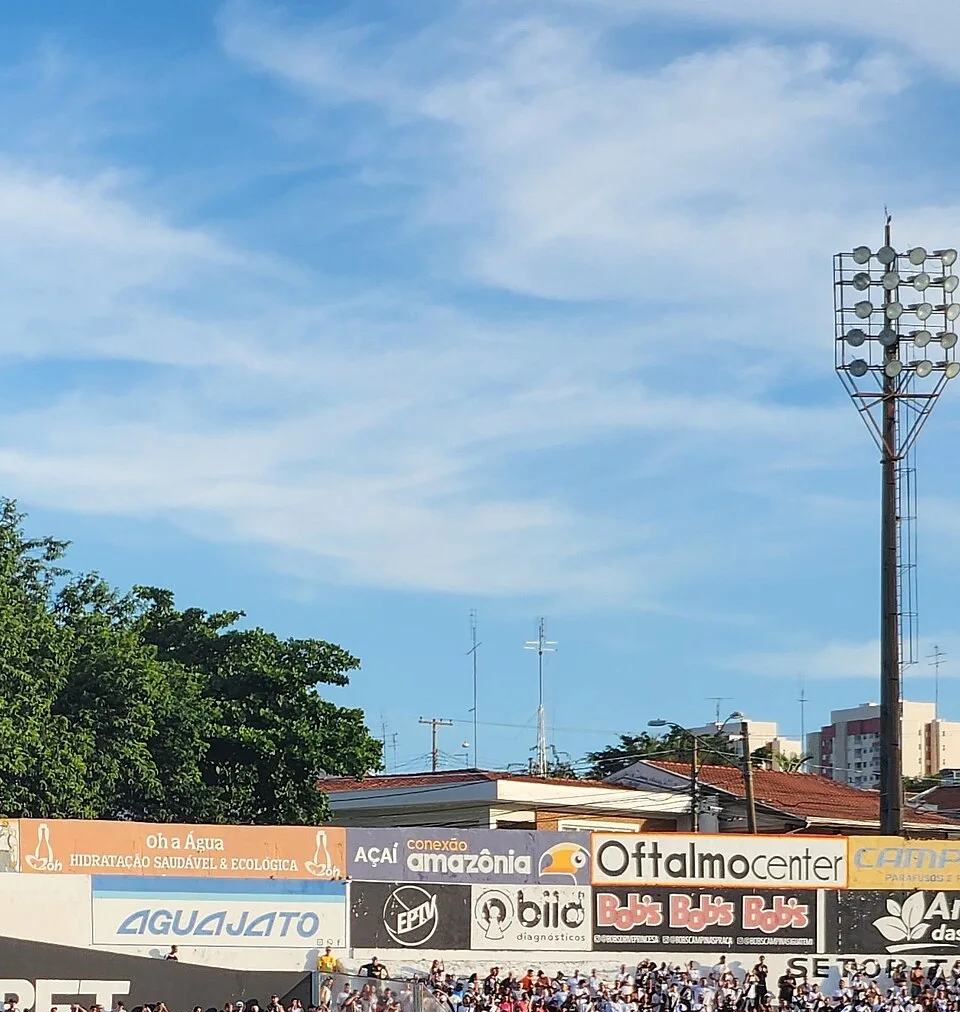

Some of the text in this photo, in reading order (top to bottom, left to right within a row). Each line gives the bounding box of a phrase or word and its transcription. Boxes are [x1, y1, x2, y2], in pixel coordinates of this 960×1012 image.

[172, 838, 181, 850] a
[184, 830, 224, 852] Água
[406, 837, 468, 851] conexão
[69, 853, 299, 872] HIDRATAÇÃO SAUDÁVEL & ECOLÓGICA
[354, 842, 399, 868] AÇAÍ
[406, 848, 532, 875] amazônia
[597, 839, 843, 882] Oftalmocenter
[396, 894, 437, 935] EPTV
[596, 892, 809, 934] Bob's Bob's Bob's
[516, 932, 586, 943] diagnósticos
